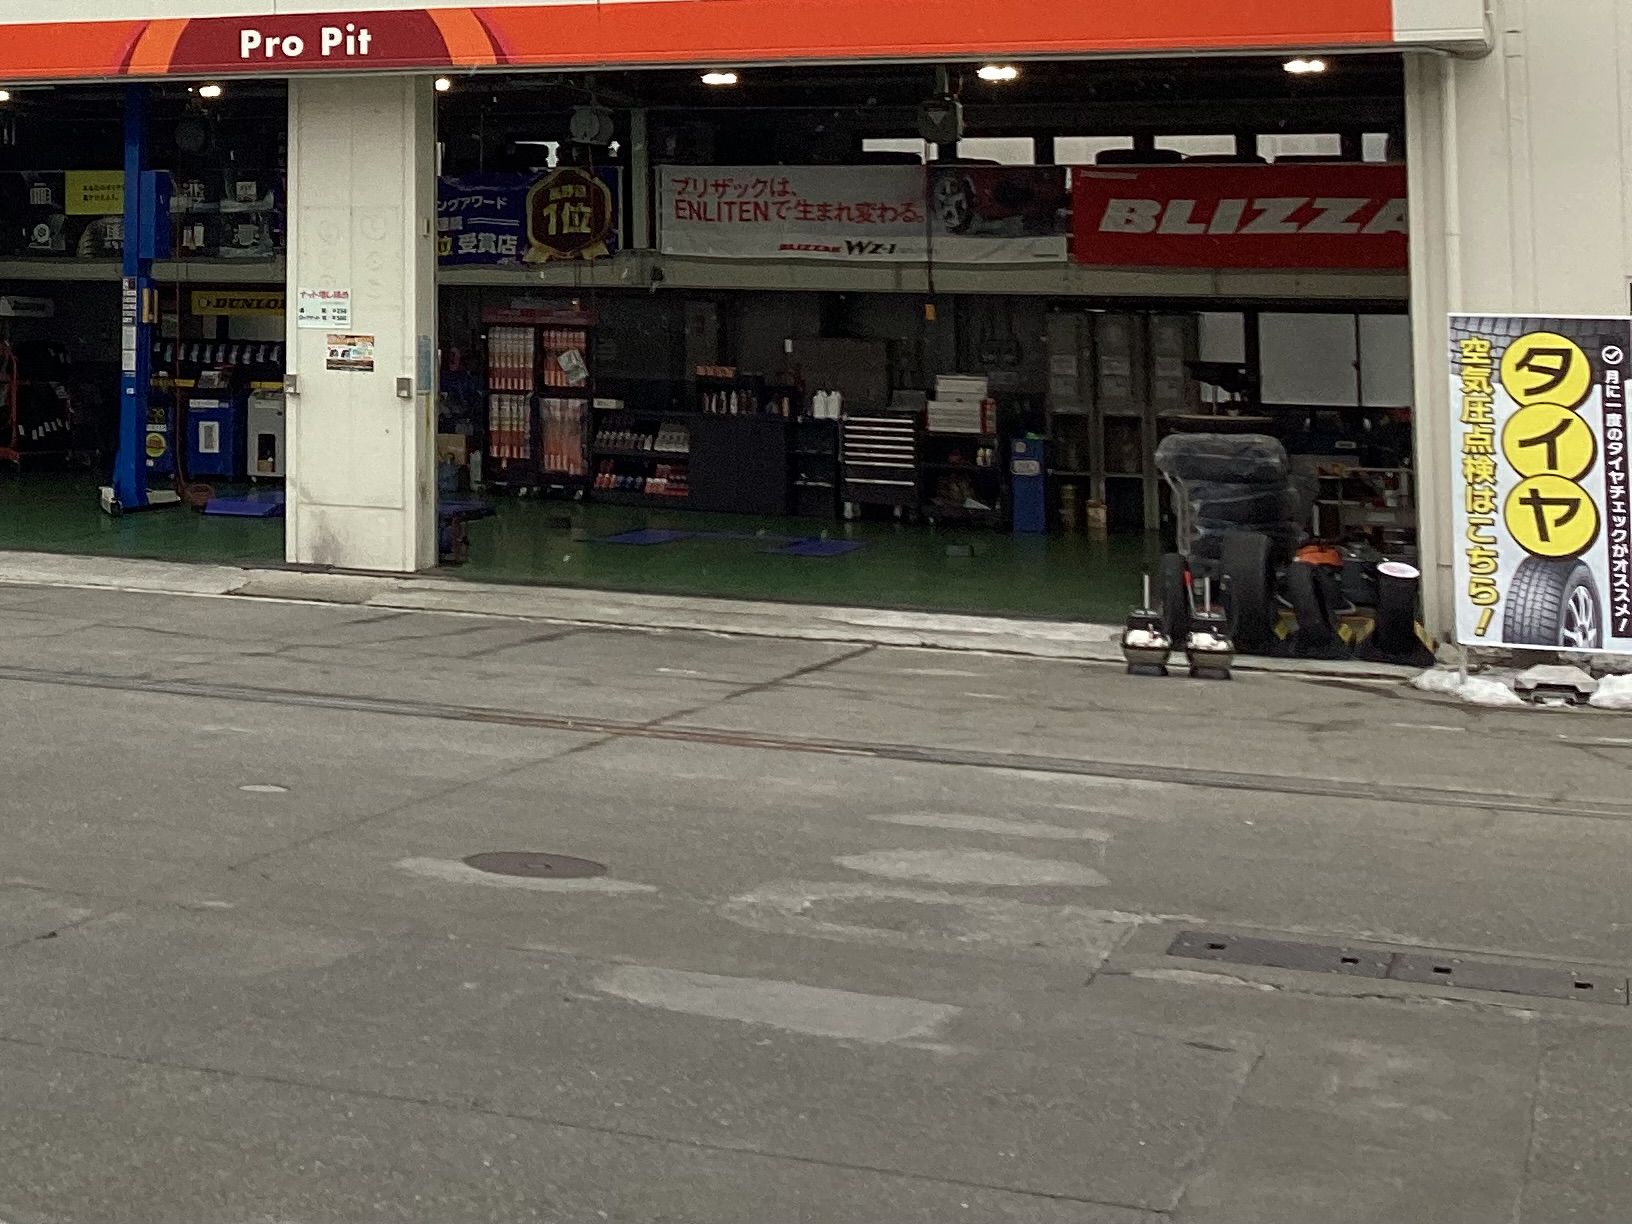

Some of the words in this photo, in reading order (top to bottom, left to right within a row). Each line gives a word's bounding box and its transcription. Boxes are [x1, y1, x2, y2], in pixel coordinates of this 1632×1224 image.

[240, 28, 304, 59] Pro
[321, 24, 372, 55] Pit
[673, 177, 797, 198] ブリザックは、
[543, 202, 593, 236] 1位
[212, 298, 285, 310] DUNLO
[1515, 348, 1581, 543] タイヤ
